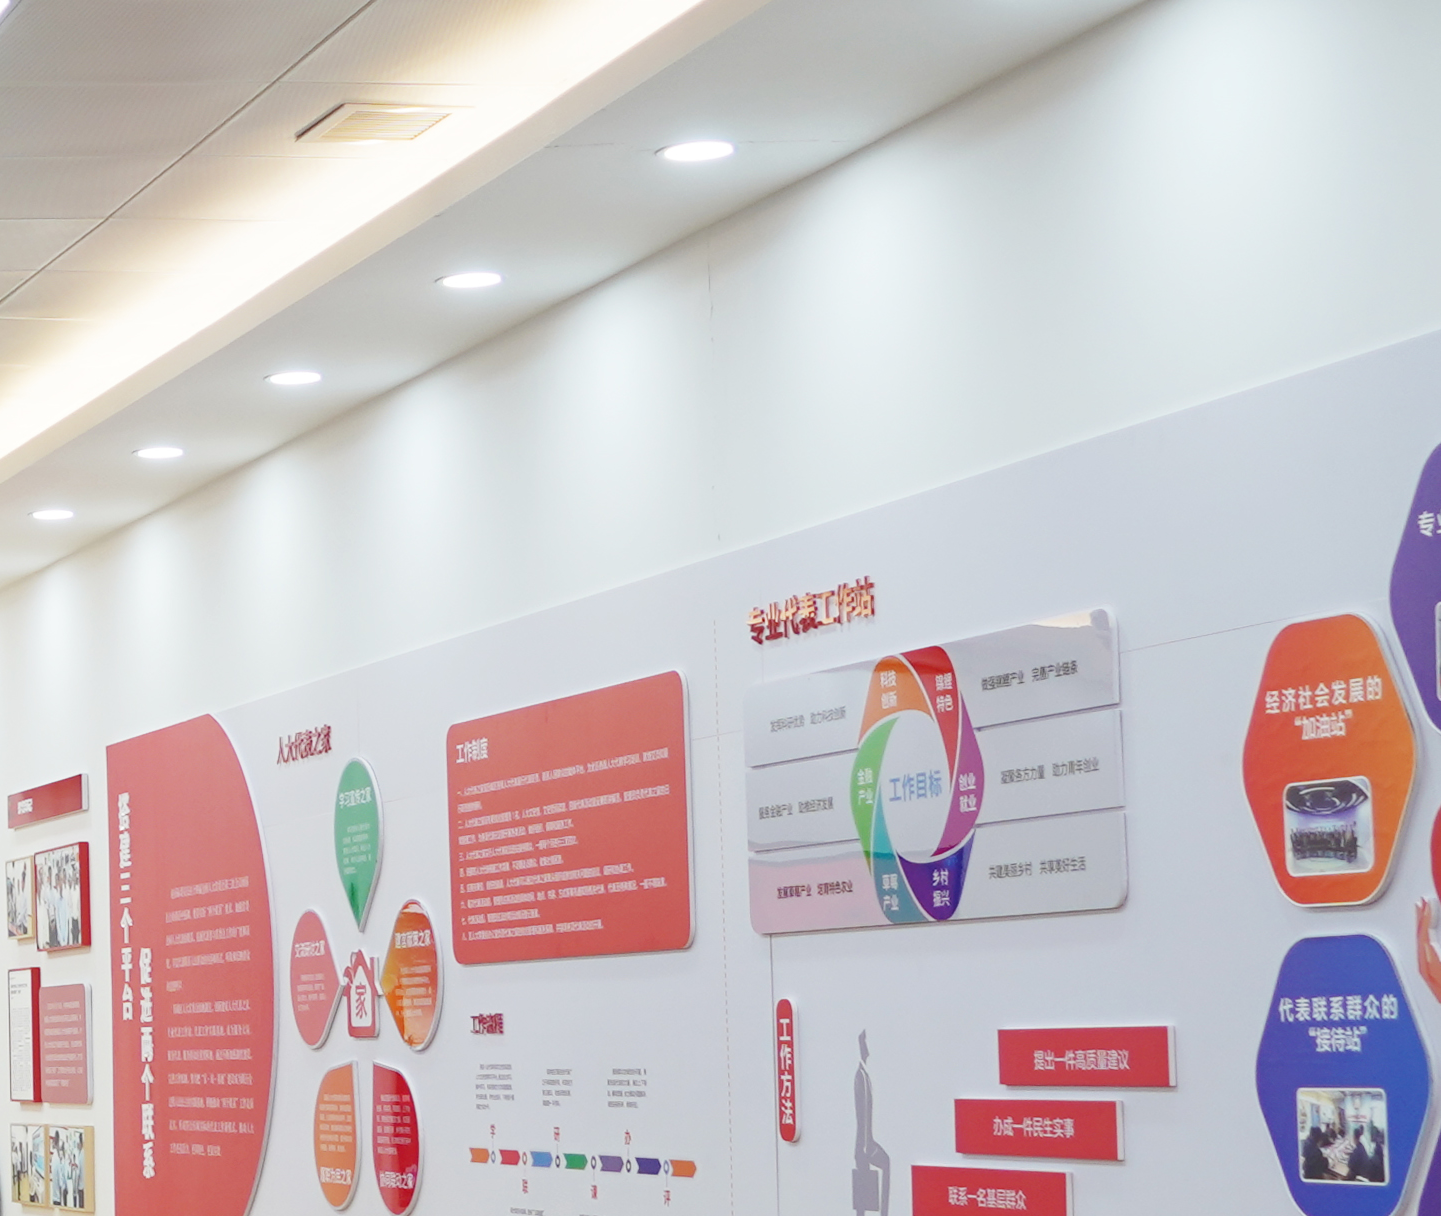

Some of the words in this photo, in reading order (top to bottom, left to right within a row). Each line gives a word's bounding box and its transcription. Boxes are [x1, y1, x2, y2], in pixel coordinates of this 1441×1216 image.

[746, 576, 875, 645] 专业代表工作站
[936, 694, 954, 713] 特色
[1265, 675, 1383, 715] 经济社会发展的
[456, 737, 488, 764] 工作制度
[889, 770, 943, 803] 工作目标
[883, 894, 899, 911] 产业
[355, 982, 367, 1019] 家
[1279, 994, 1398, 1023] 代表联系群众的
[779, 1018, 794, 1125] 工作方法
[1033, 1050, 1130, 1072] 提出一件高质量建议
[993, 1115, 1075, 1139] 办成一件民生实事
[948, 1186, 1026, 1210] 联系一名基层群众
